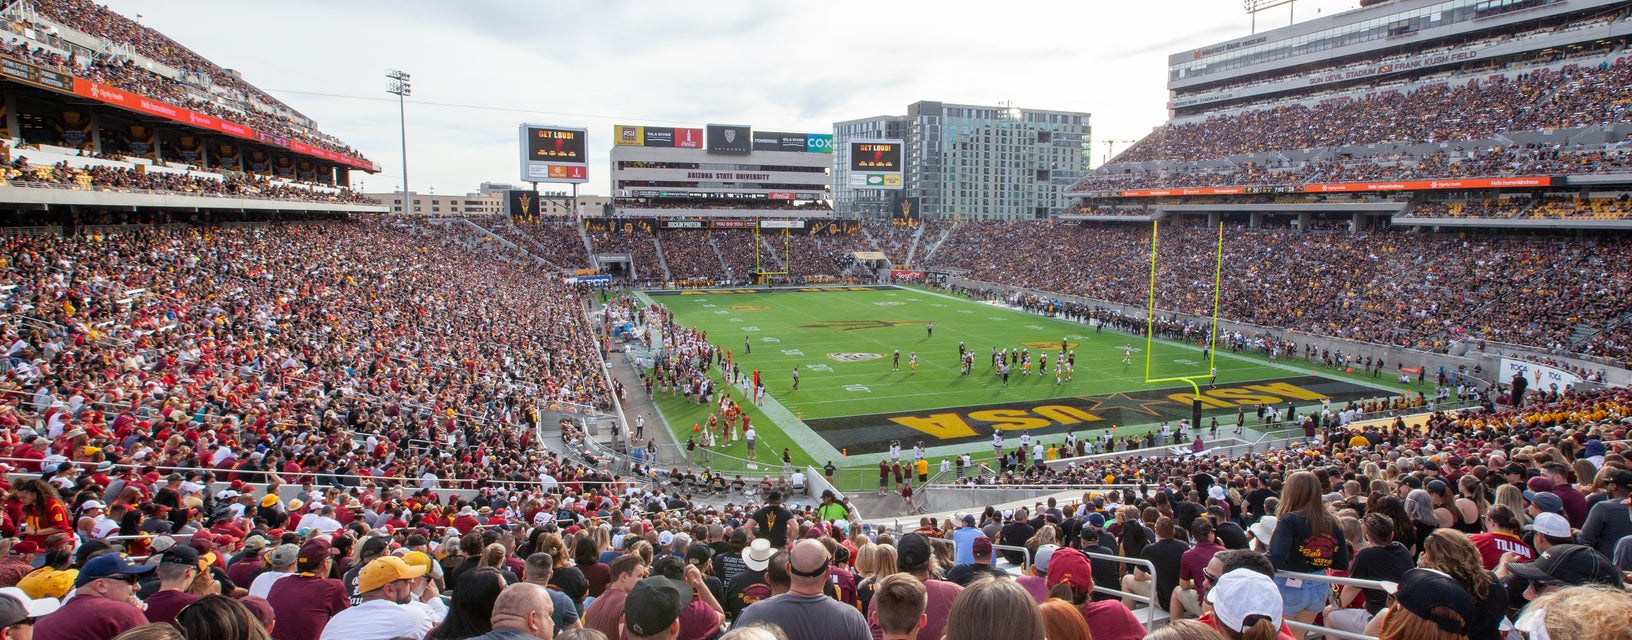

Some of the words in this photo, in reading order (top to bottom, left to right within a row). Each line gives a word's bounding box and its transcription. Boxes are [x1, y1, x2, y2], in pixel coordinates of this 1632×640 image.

[1394, 60, 1422, 72] FRANK
[1424, 56, 1448, 66] KUSH
[1452, 50, 1477, 61] FIELD
[1326, 74, 1344, 82] DEVIL
[1346, 68, 1376, 78] STADIUM
[538, 130, 552, 138] GET
[554, 132, 574, 140] LOUD!
[808, 138, 832, 148] COX
[1510, 363, 1528, 372] TOCA
[1549, 372, 1562, 382] TOCA
[1494, 538, 1531, 559] TILLMAN
